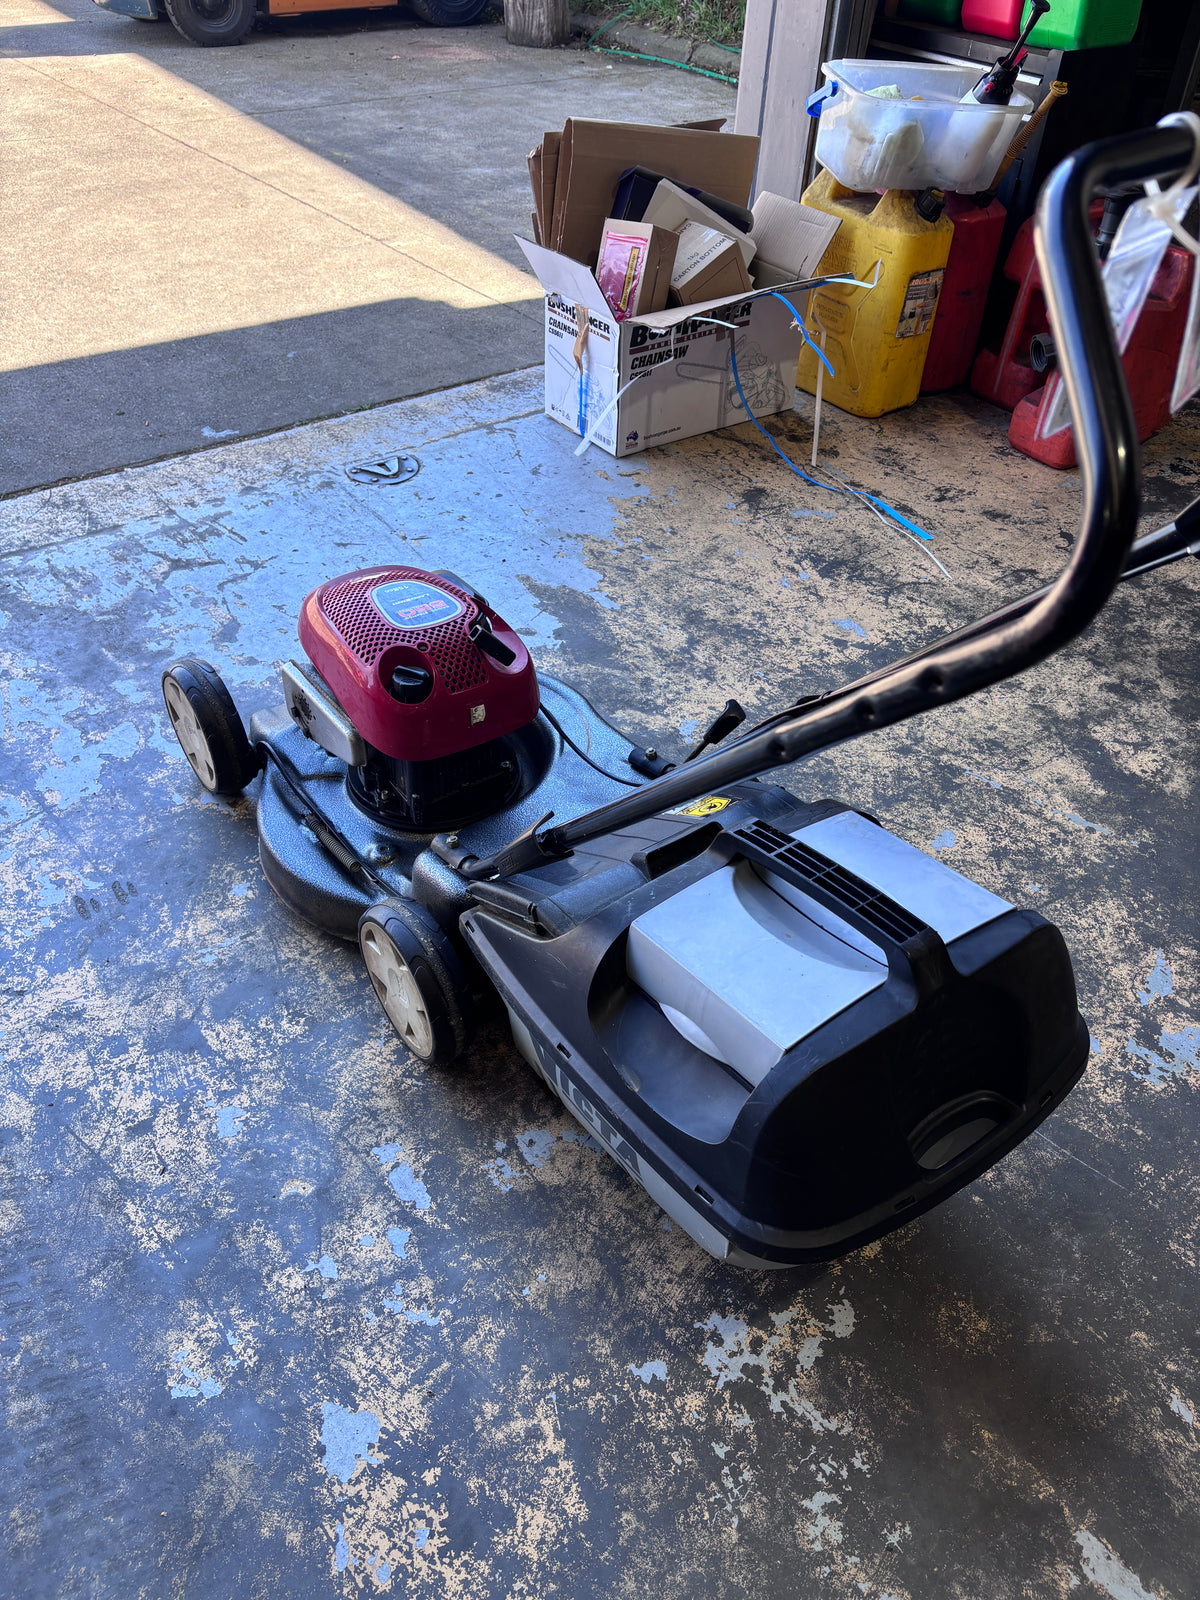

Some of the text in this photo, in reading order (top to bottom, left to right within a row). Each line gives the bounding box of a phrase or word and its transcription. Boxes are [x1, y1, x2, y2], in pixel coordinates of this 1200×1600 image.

[673, 237, 727, 282] CARTON BOTTOM
[547, 296, 610, 335] BUSHNGER
[630, 345, 689, 370] CHAINSAW
[529, 1031, 640, 1175] VICTA
